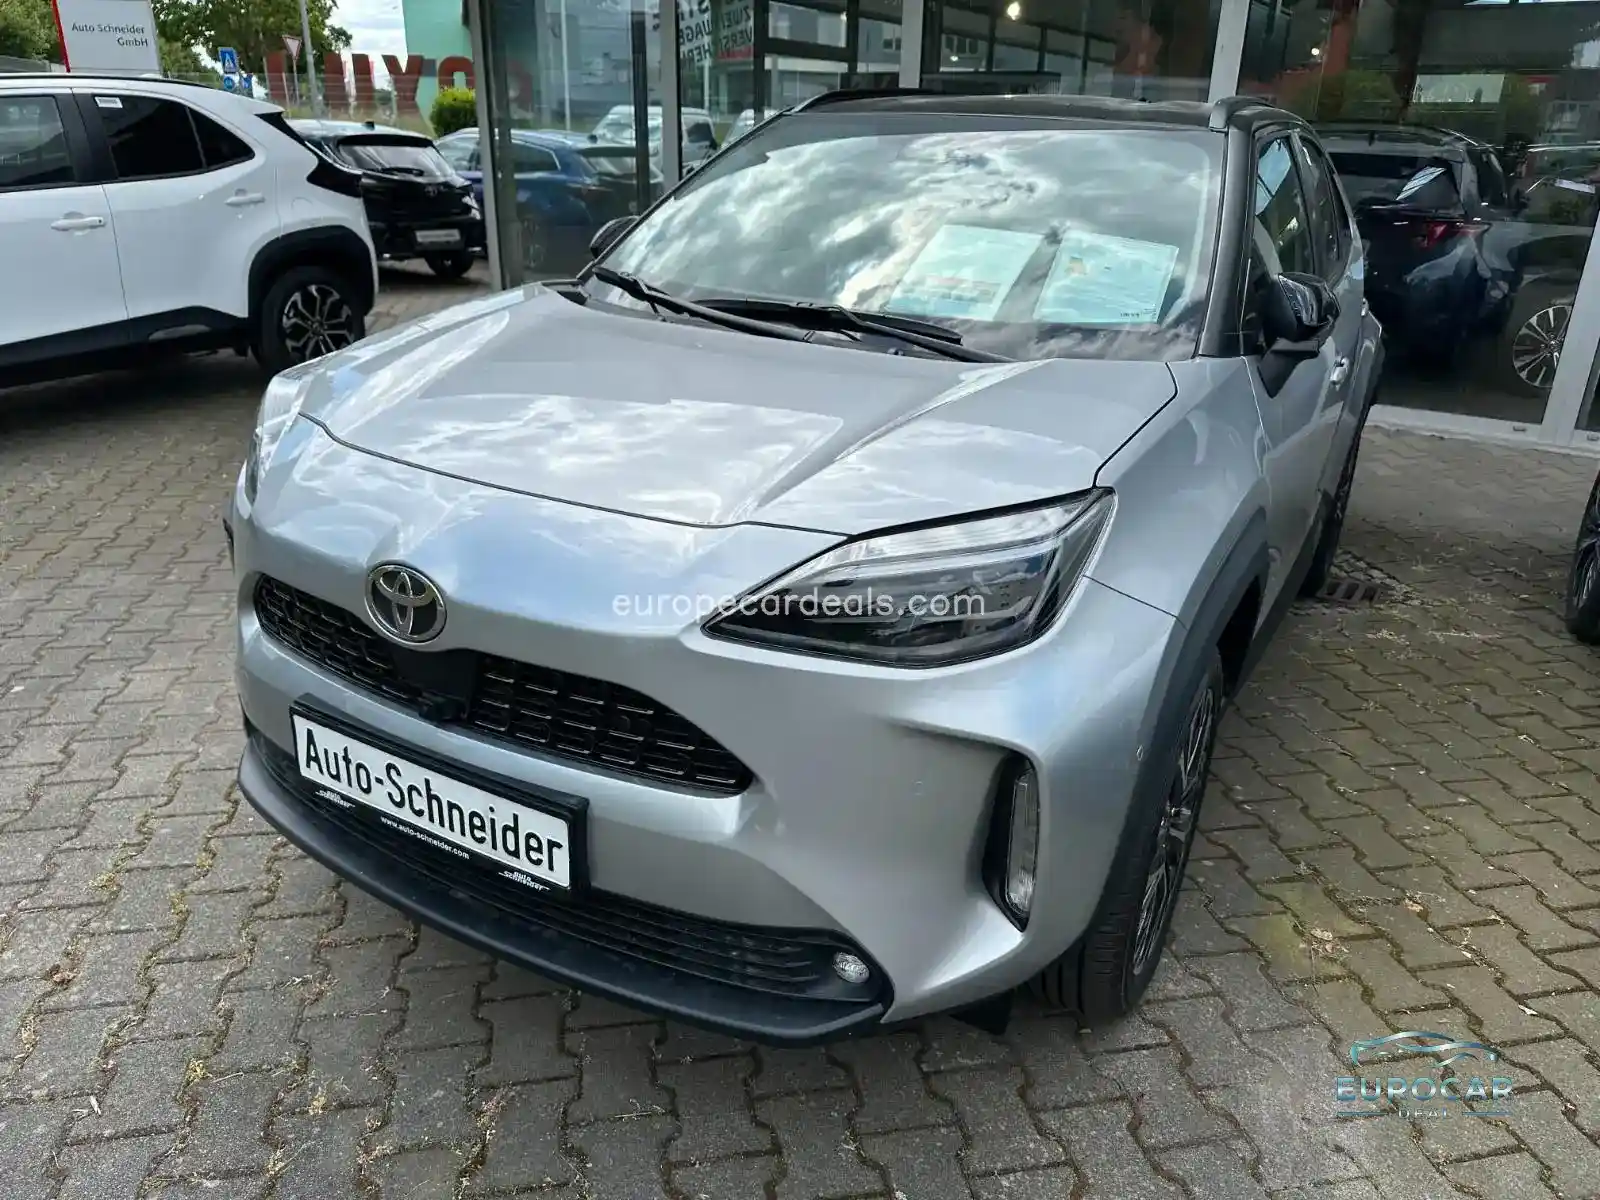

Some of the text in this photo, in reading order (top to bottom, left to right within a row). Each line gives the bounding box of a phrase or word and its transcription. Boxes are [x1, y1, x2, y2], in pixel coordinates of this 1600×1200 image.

[72, 22, 145, 34] Auto Schneider
[117, 37, 149, 46] GmbH
[305, 727, 564, 872] Auto-Schneider
[380, 815, 470, 860] www.auto-schneider.com
